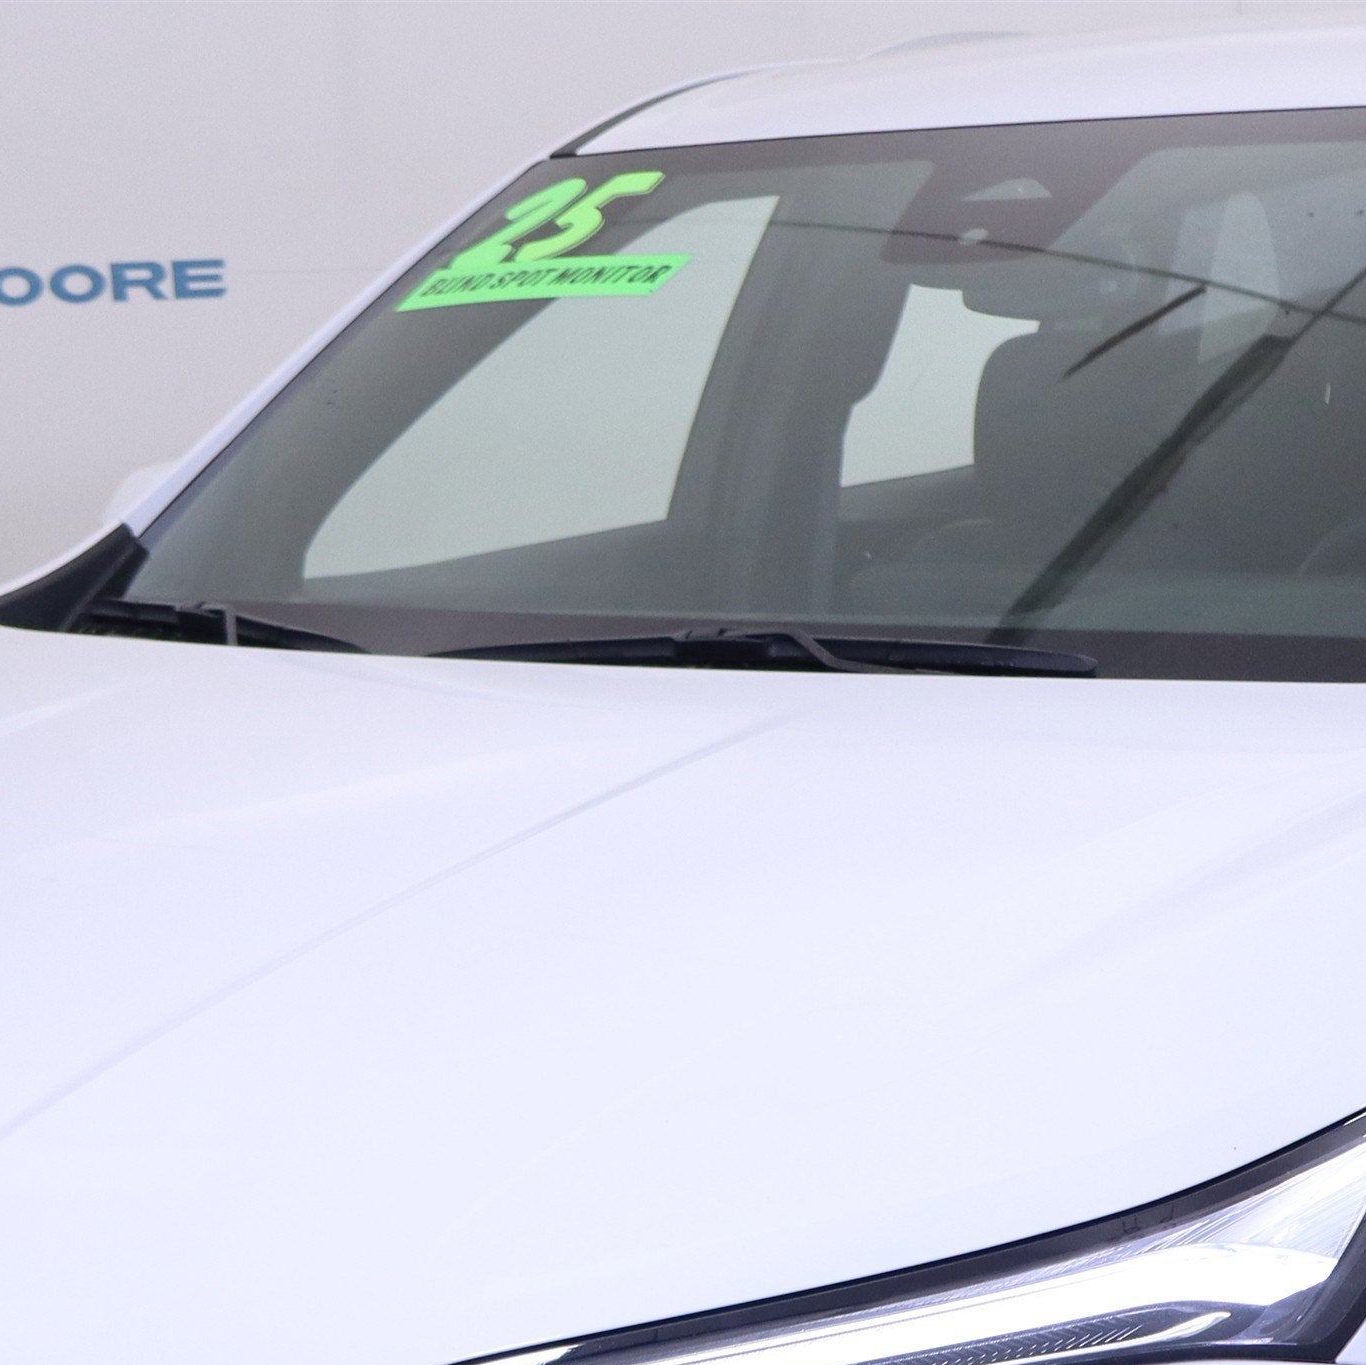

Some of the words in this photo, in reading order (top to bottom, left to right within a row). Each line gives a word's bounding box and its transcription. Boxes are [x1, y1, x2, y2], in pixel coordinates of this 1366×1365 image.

[447, 170, 666, 272] 25
[489, 268, 558, 289] SPOT
[549, 264, 672, 286] MONITOR
